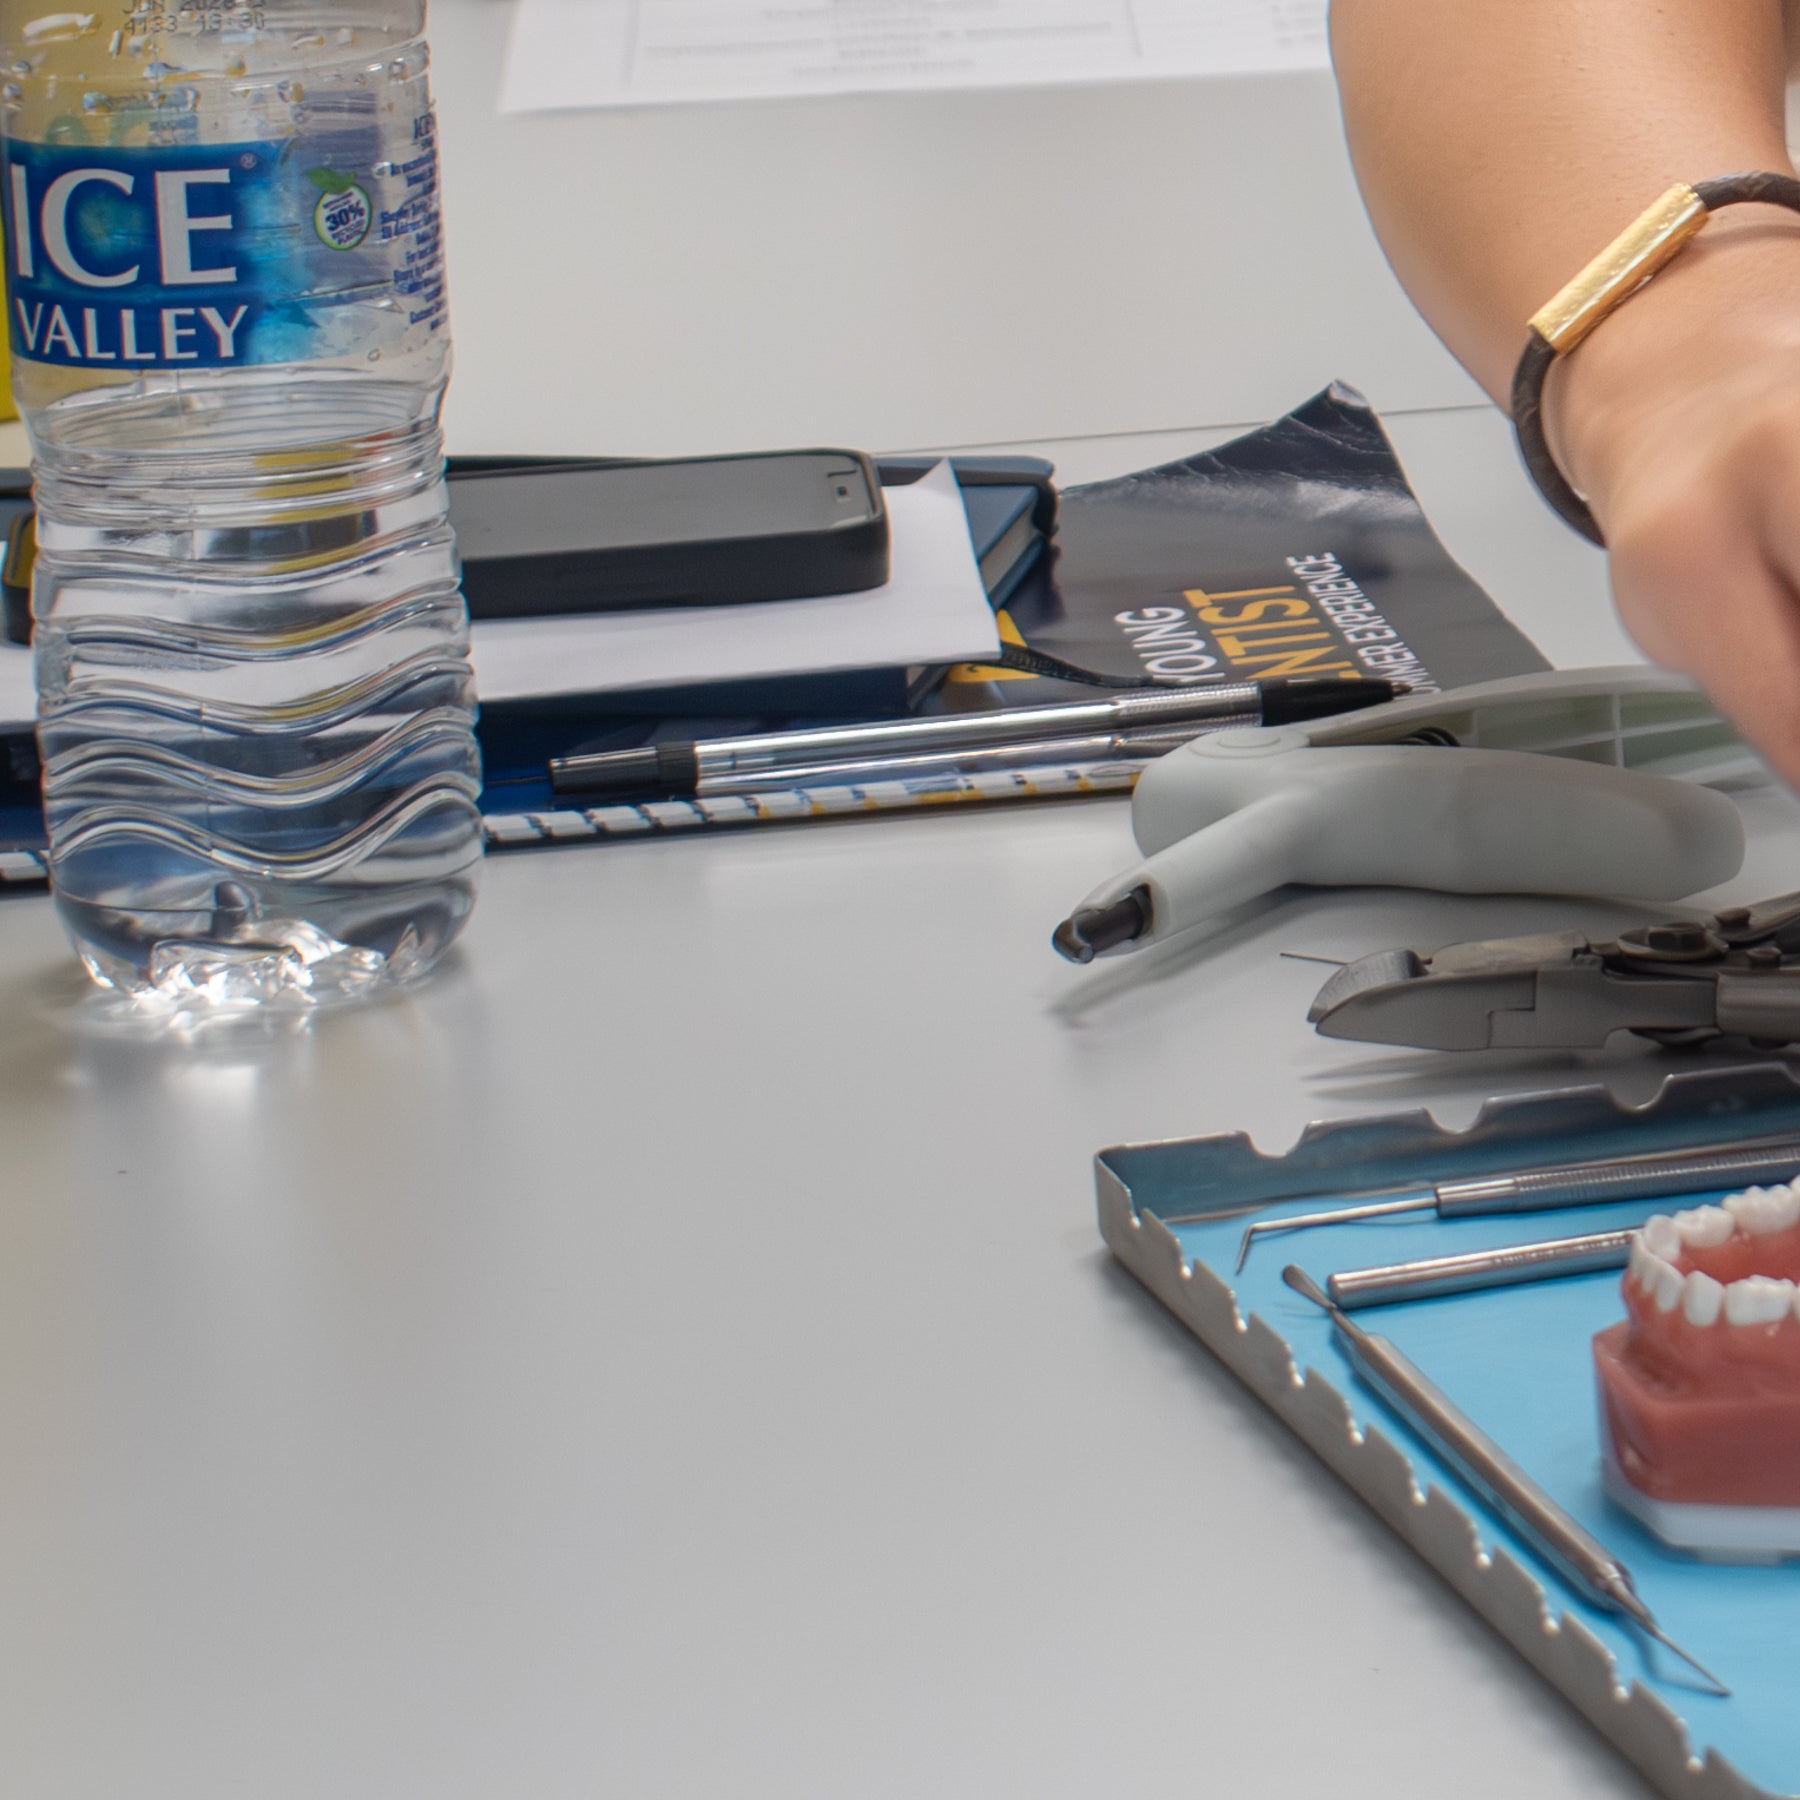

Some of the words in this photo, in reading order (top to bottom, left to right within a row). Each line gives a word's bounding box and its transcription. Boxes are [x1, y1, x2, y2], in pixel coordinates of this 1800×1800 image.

[10, 163, 238, 288] ICE
[325, 200, 365, 232] 30%
[15, 297, 249, 361] VALLEY
[1182, 585, 1362, 680] NTIST
[1285, 551, 1398, 644] EXPERIENCE
[1114, 606, 1225, 683] YOUNG
[1356, 641, 1443, 696] UMMER
